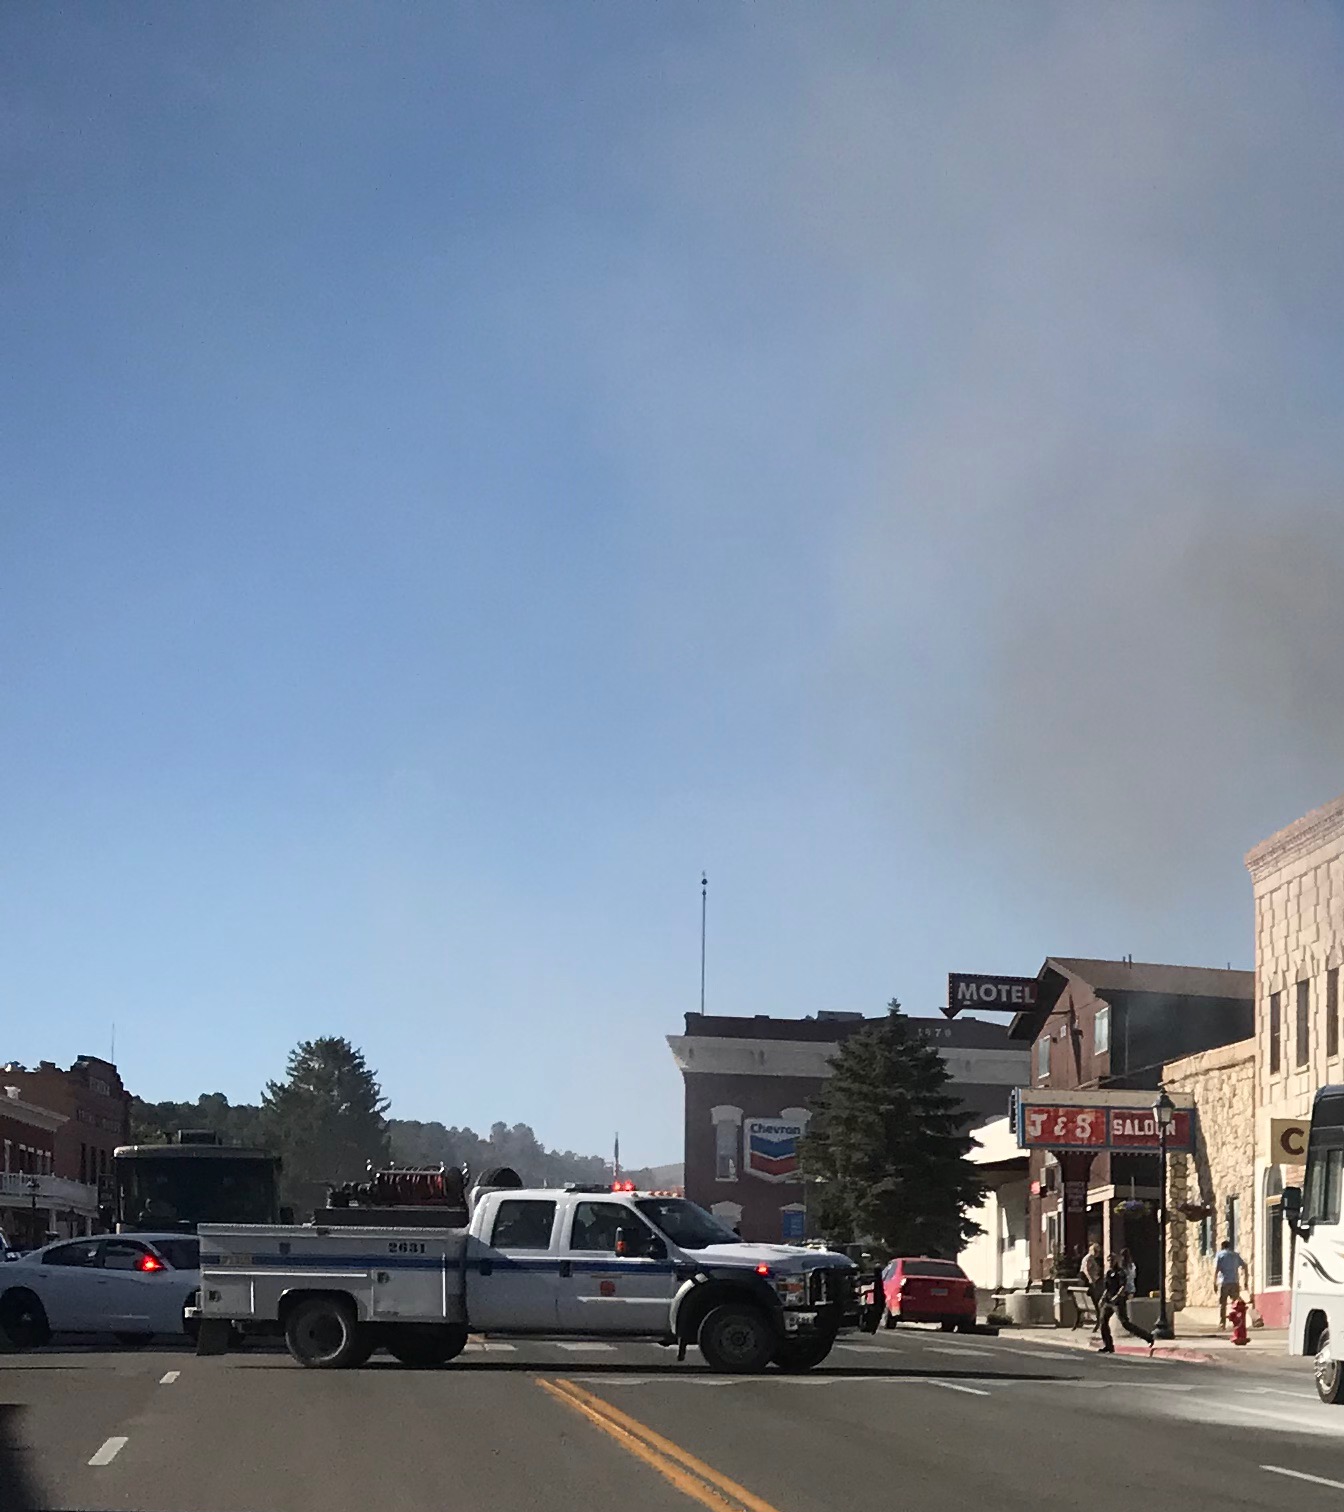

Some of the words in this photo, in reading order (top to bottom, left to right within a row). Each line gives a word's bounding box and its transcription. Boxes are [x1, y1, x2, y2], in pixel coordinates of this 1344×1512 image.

[957, 982, 1036, 1003] MOTEL
[750, 1122, 801, 1135] Chevron
[1029, 1113, 1048, 1137] J
[1054, 1116, 1067, 1136] &
[1075, 1114, 1097, 1138] S
[388, 1242, 426, 1254] 2631
